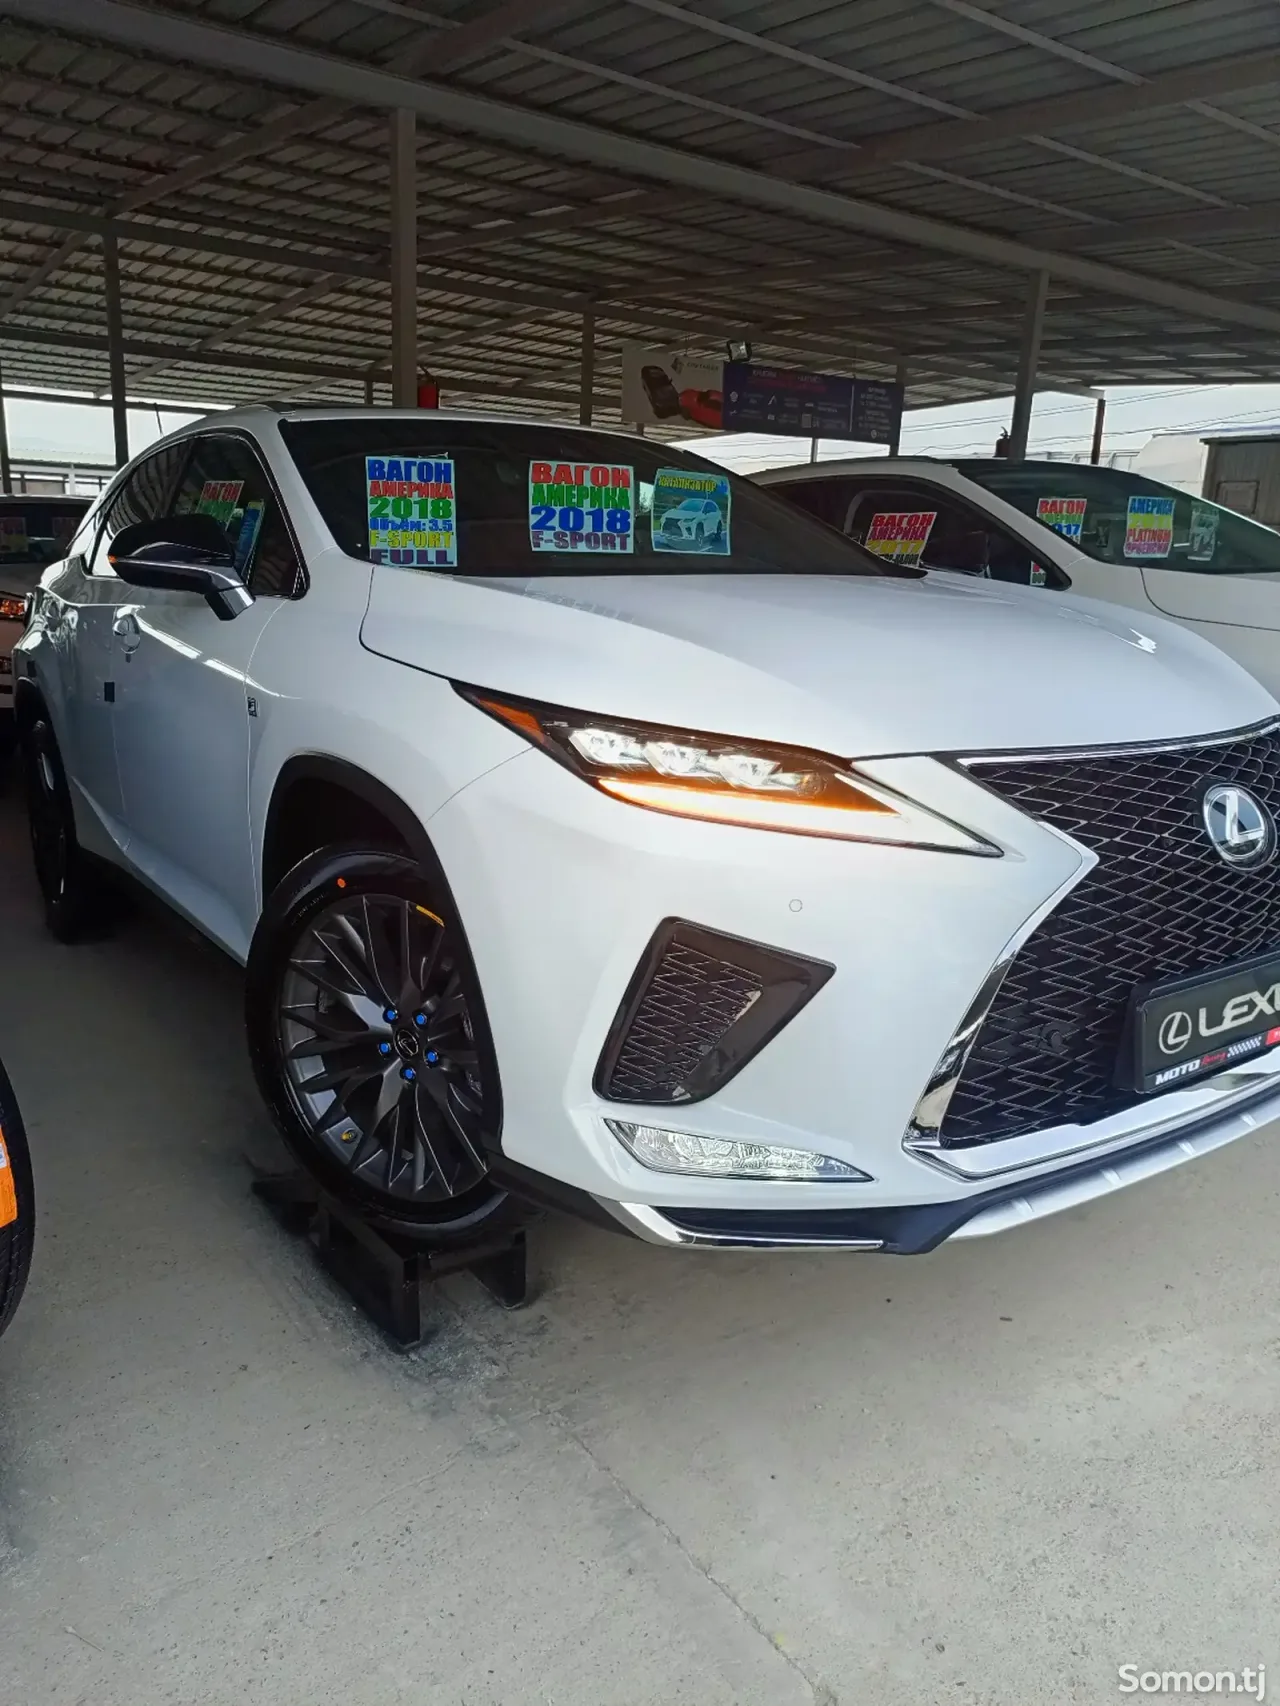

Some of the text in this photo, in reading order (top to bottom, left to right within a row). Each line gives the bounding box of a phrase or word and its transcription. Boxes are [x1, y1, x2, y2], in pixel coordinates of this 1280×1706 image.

[368, 460, 451, 483] ВАГОН
[531, 462, 630, 488] ВАГОН
[370, 481, 453, 498] АМЕРИКА
[532, 484, 630, 510] АМЕРИКА
[369, 497, 452, 519] 2018
[1039, 500, 1085, 514] ВАГОН
[429, 519, 453, 531] 3.5
[531, 506, 630, 533] 2018
[873, 514, 935, 527] ВАГОН
[370, 530, 453, 548] F-SPORT
[531, 531, 630, 550] F-SPORT
[868, 526, 929, 540] АМЕРИКА
[1127, 527, 1172, 543] PLATINUM
[370, 548, 453, 564] FULL
[866, 540, 925, 555] 2017
[1155, 1059, 1200, 1085] MOTO
